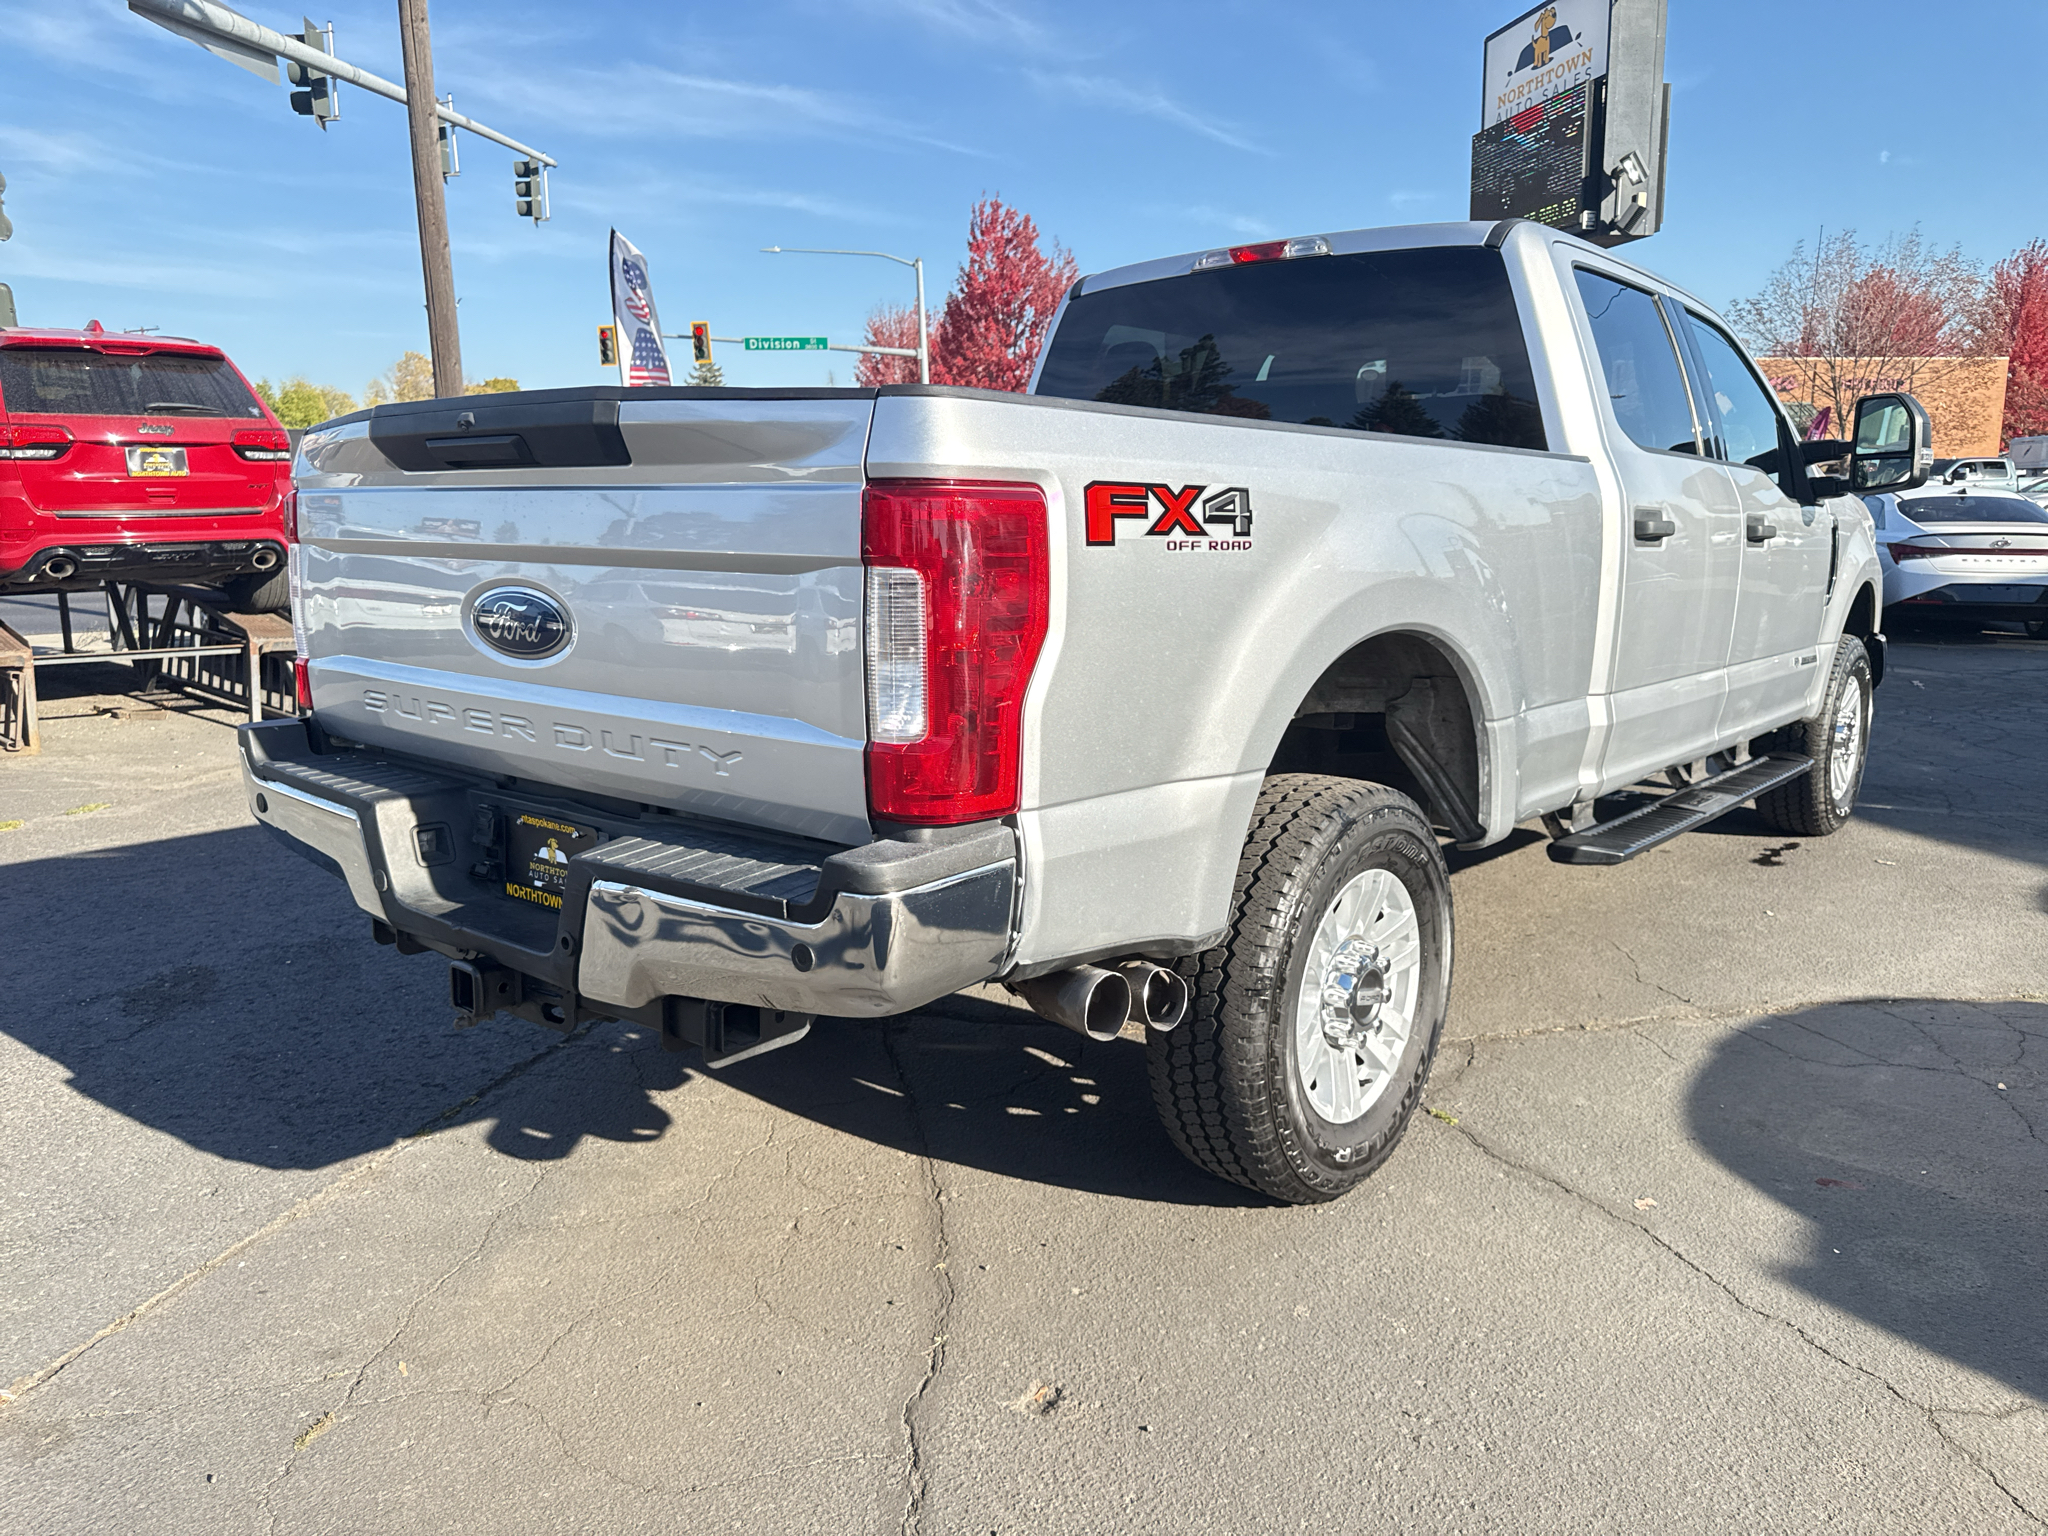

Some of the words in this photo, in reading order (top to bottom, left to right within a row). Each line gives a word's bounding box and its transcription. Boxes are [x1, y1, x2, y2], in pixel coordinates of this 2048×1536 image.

[1497, 47, 1593, 110] NORTHTOWN
[1496, 97, 1533, 123] AUTO
[749, 338, 800, 349] Division
[137, 422, 175, 437] Jeep
[1083, 480, 1253, 547] FX4
[1166, 540, 1202, 551] OFF
[1208, 540, 1253, 551] ROAD
[488, 600, 542, 644] Ford
[363, 689, 537, 743] SUPER
[553, 721, 743, 777] DUTY
[520, 814, 577, 834] ntaspokane.com
[528, 869, 550, 882] AUTO
[553, 875, 567, 885] SA
